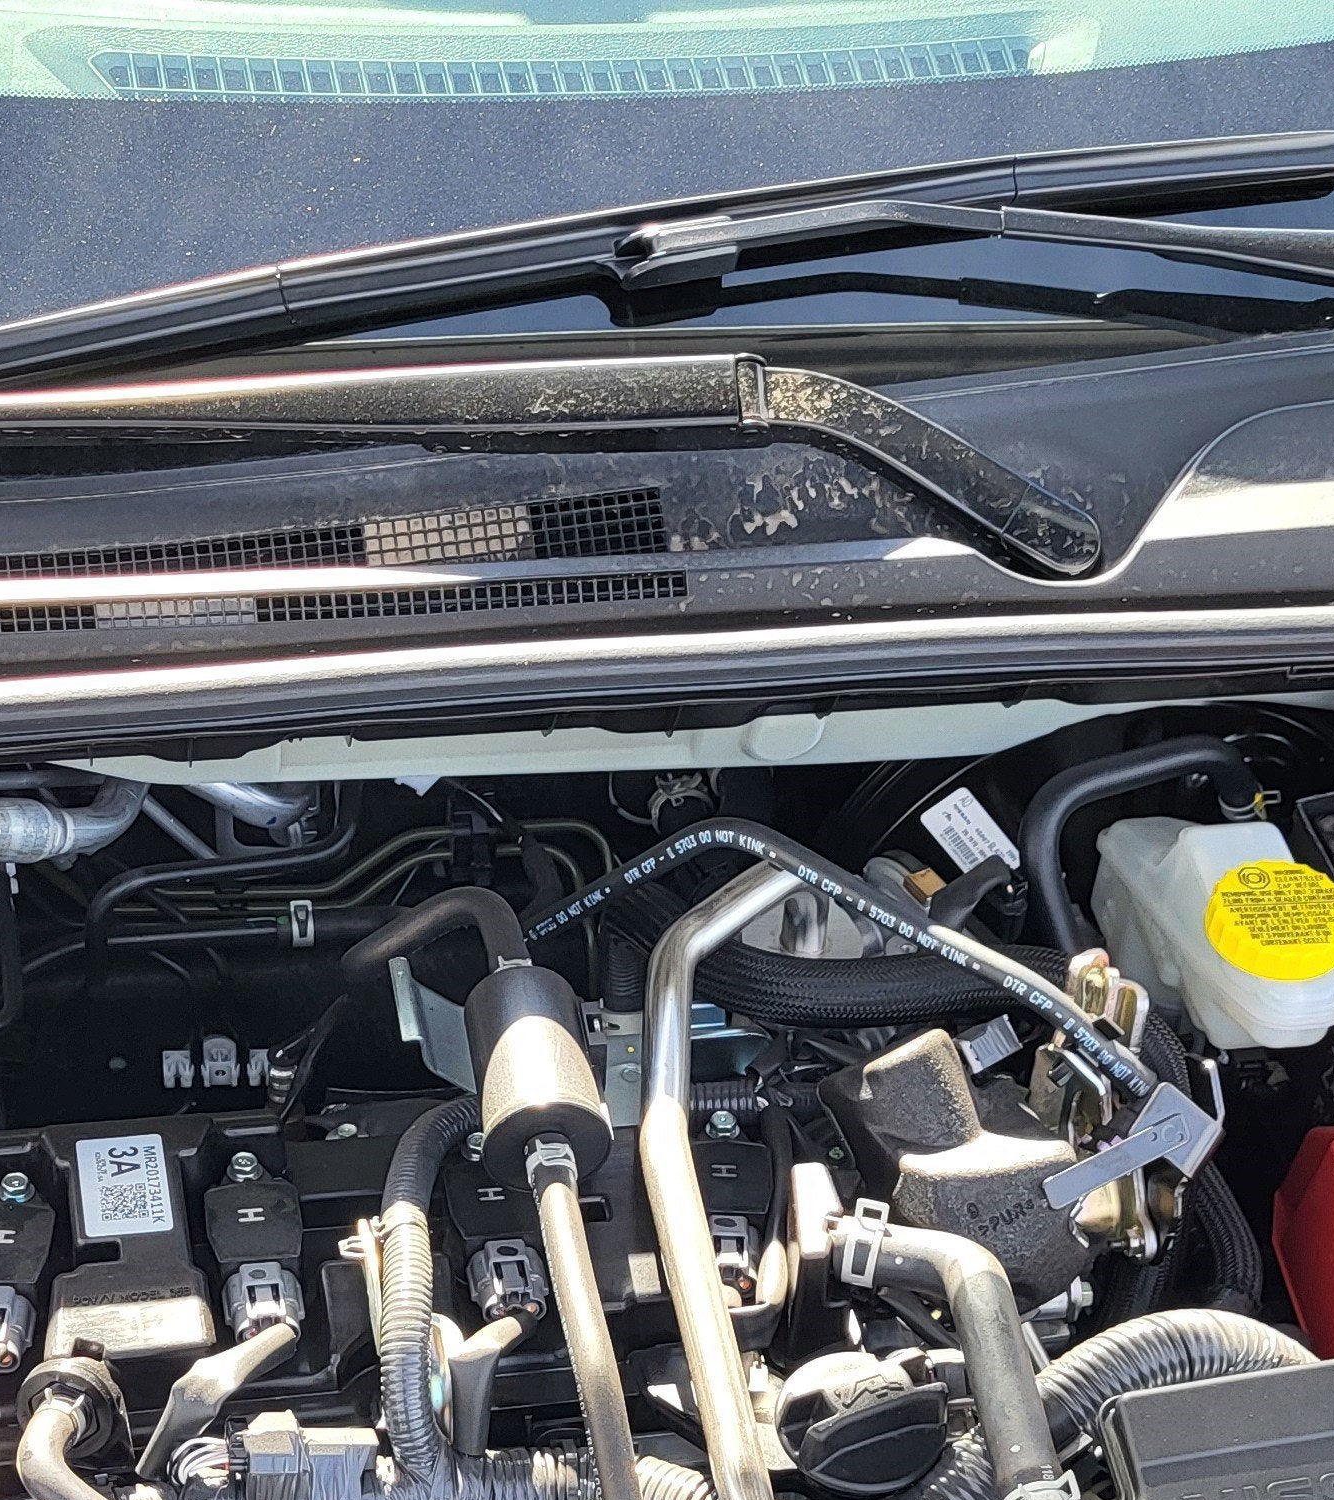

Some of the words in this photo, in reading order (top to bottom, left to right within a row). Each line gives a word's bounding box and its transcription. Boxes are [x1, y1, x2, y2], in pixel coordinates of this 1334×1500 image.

[565, 899, 585, 918] NOT
[581, 888, 606, 909] KINK
[639, 856, 658, 875] CFP
[674, 833, 698, 855] 5703
[712, 829, 737, 842] NOT
[735, 835, 768, 853] KINK
[794, 863, 821, 885] DTR
[818, 877, 843, 898] CFP
[865, 904, 898, 929] 5703
[896, 920, 916, 939] DO
[913, 930, 939, 952] NOT
[937, 943, 970, 968] KINK
[1000, 974, 1029, 997] DTR
[1026, 989, 1054, 1015] CFP
[1072, 1025, 1101, 1053] 5703
[1109, 1060, 1132, 1082] NOT
[1125, 1073, 1151, 1098] KIN
[107, 1145, 141, 1177] 3A
[142, 1145, 165, 1224] MR20173411K
[1039, 1462, 1054, 1481] 118
